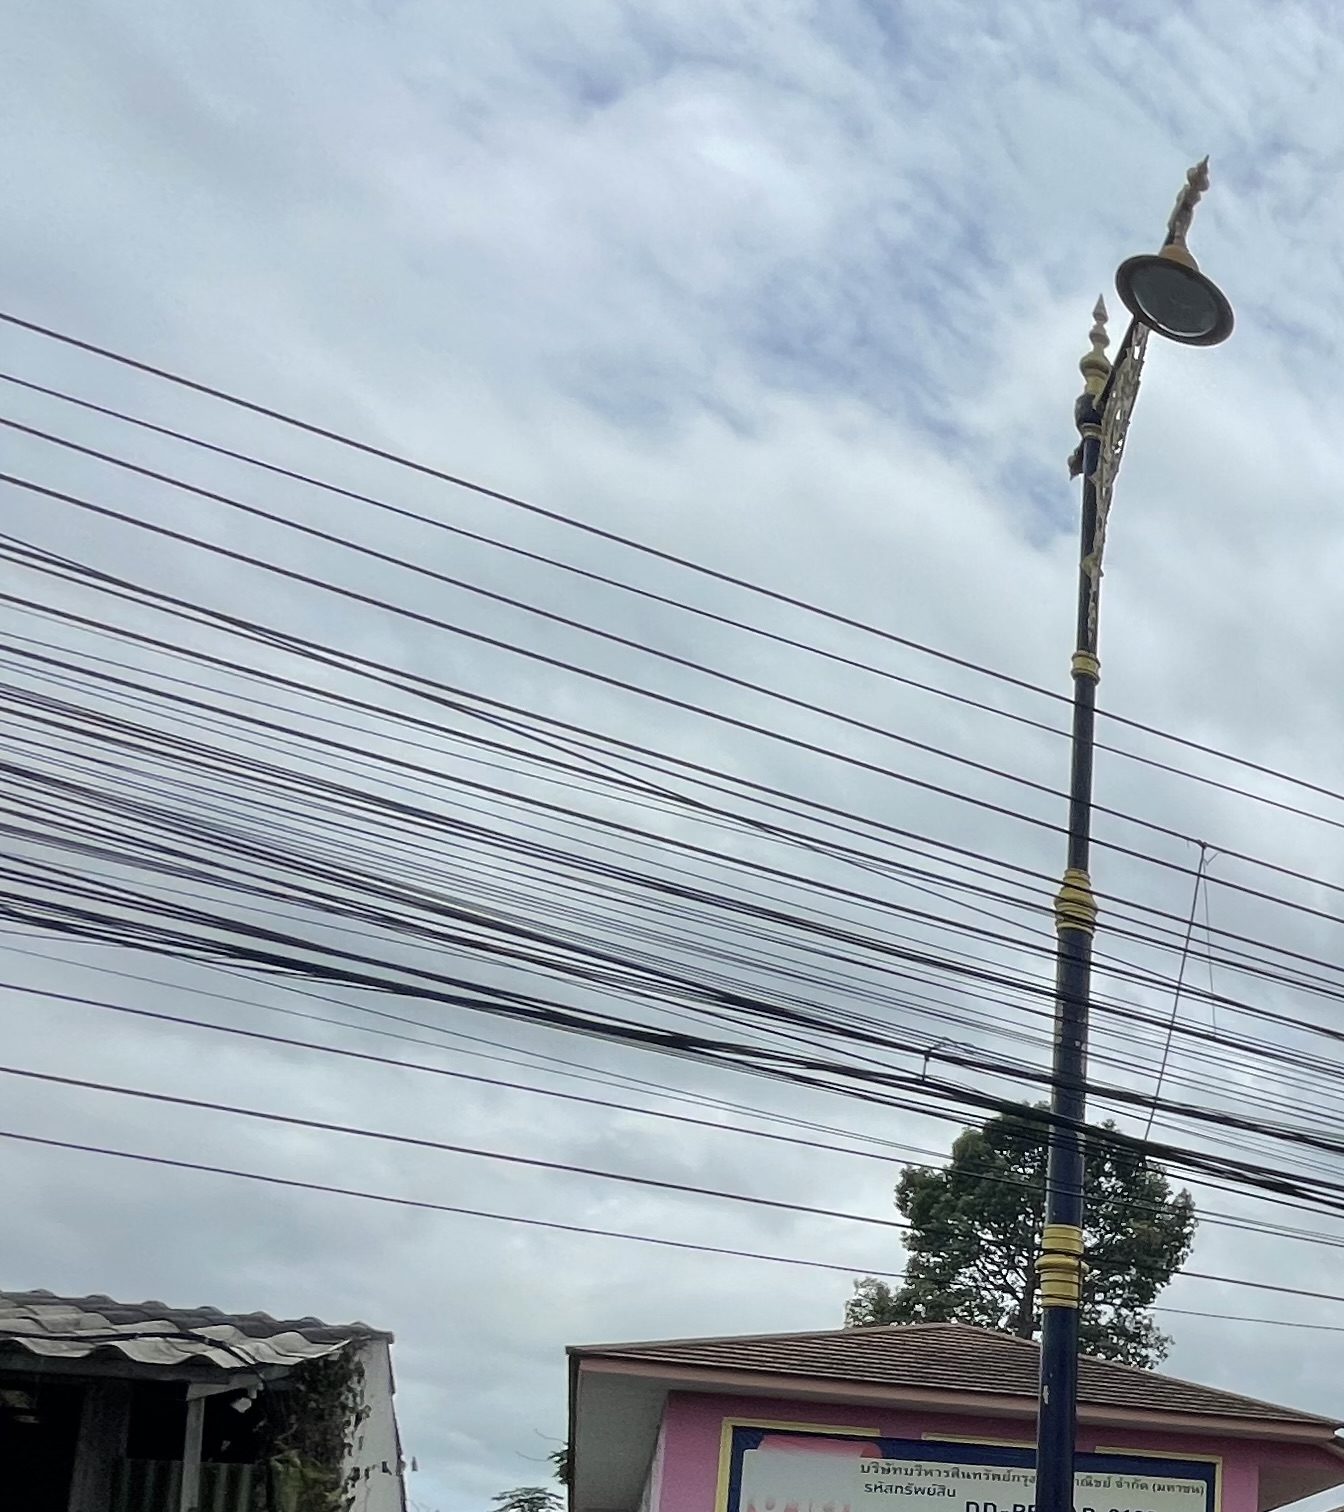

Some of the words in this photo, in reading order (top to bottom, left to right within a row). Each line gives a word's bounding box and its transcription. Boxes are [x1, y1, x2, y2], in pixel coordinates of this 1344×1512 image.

[863, 1481, 957, 1498] รหัสทรัพย์สิน
[1115, 1476, 1149, 1491] จำกัด
[1151, 1481, 1205, 1497] (มหาชน)
